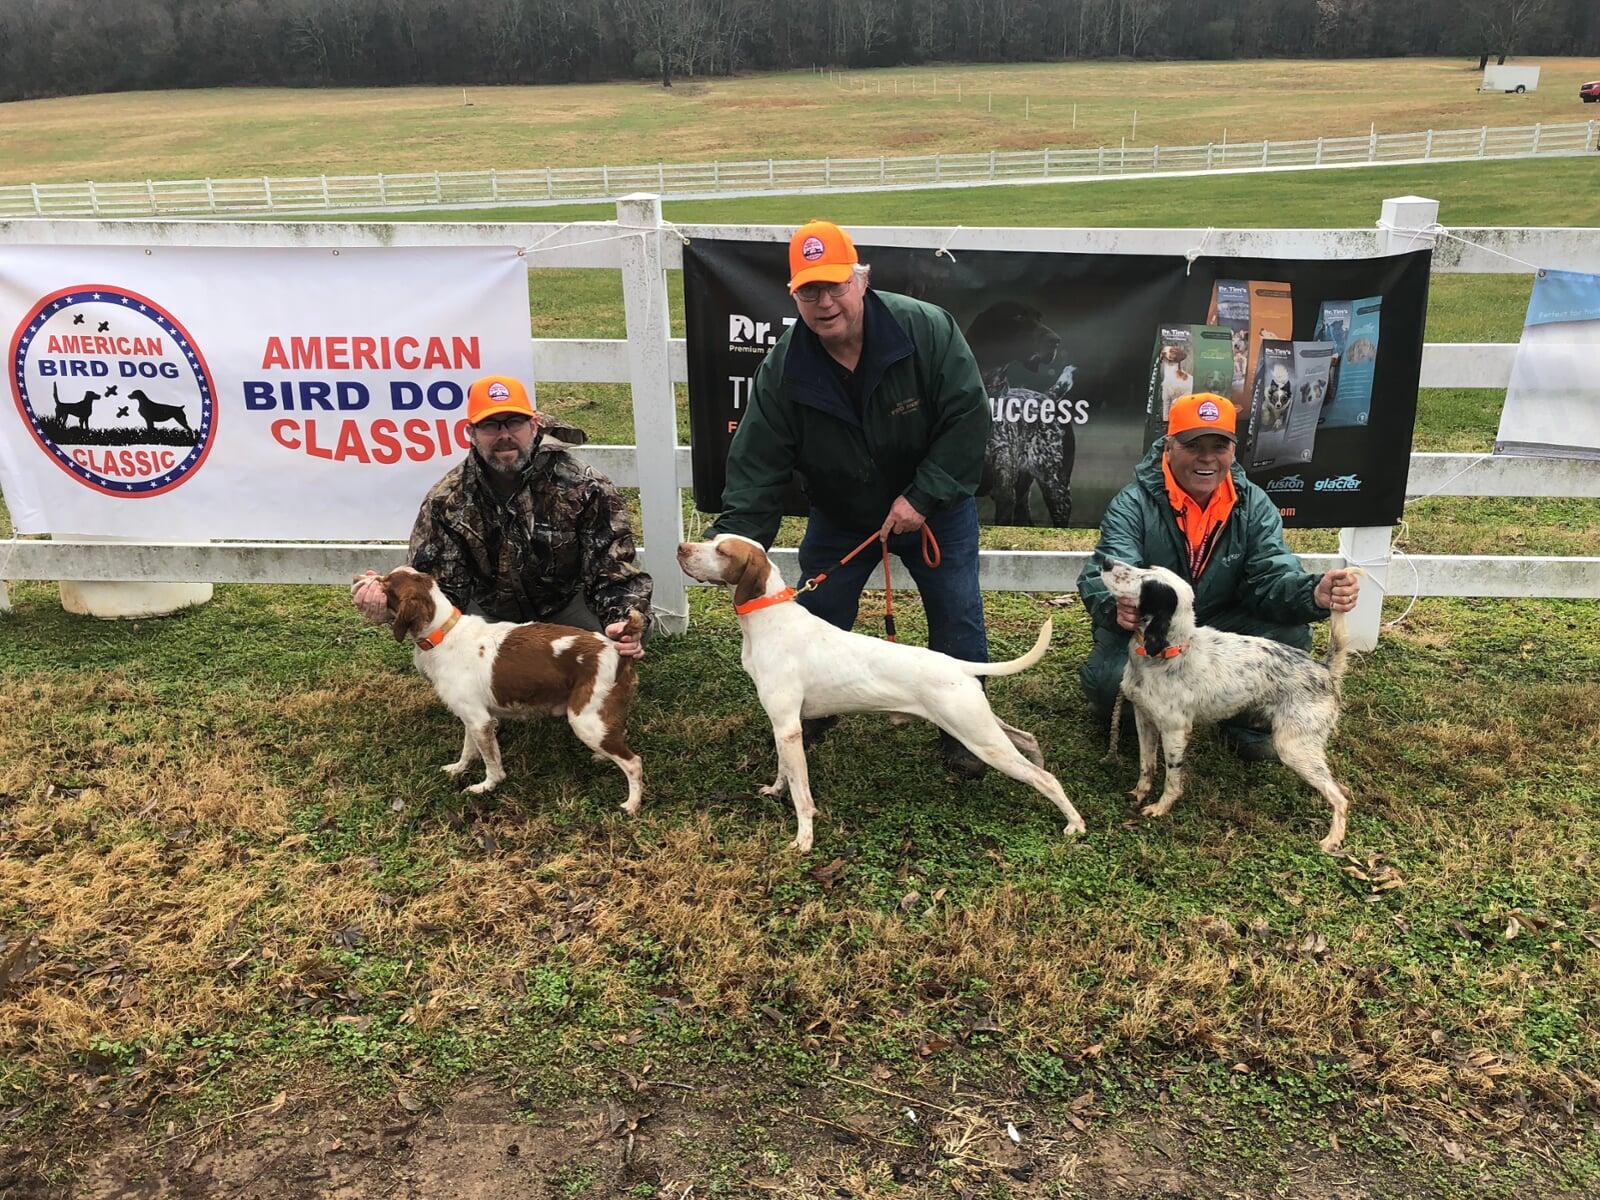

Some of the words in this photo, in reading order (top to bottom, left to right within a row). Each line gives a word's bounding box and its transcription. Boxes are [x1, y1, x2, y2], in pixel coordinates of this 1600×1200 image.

[729, 314, 777, 345] Dr.
[47, 335, 163, 357] AMERICAN
[261, 336, 481, 370] AMERICAN
[729, 344, 765, 354] Premium
[38, 359, 109, 377] BIRD
[118, 361, 179, 379] DOG
[243, 381, 370, 411] BIRD
[390, 380, 474, 411] DO
[989, 397, 1090, 425] uccess
[72, 448, 176, 478] CLASSIC
[1266, 479, 1305, 490] fusion
[1313, 478, 1362, 491] glacier
[1277, 507, 1296, 517] om
